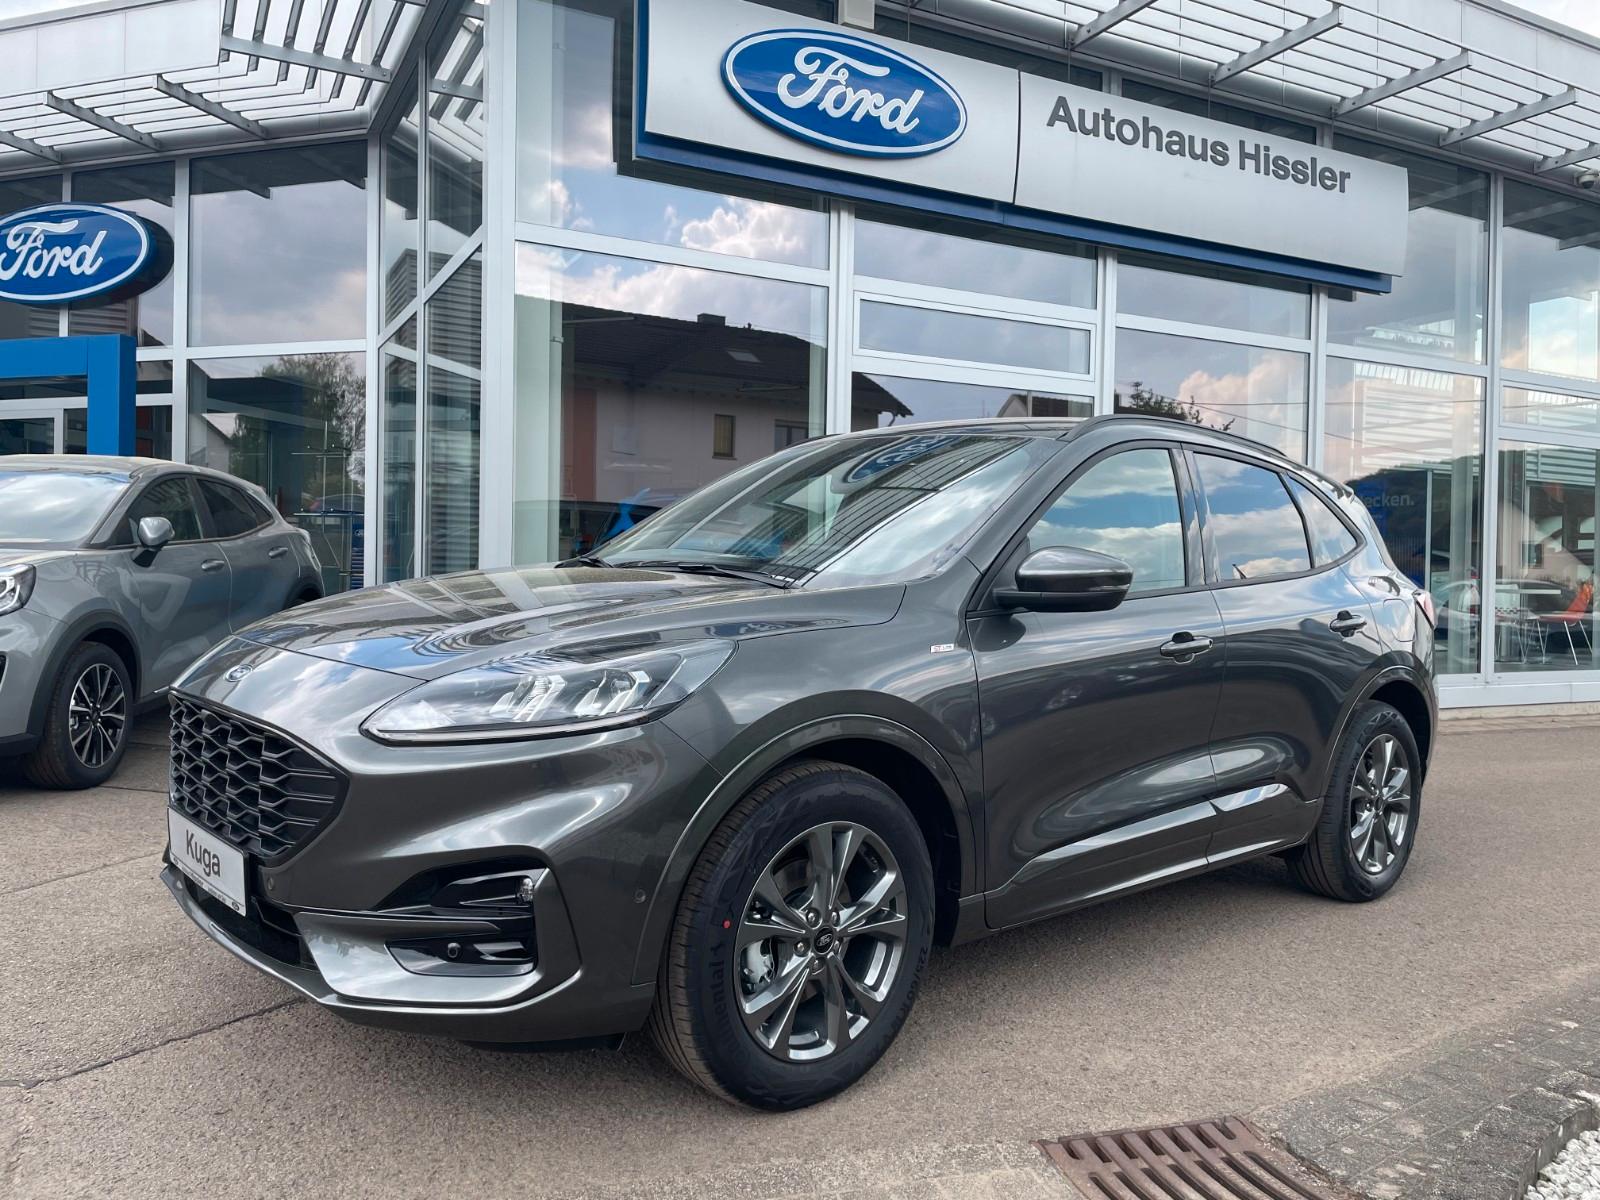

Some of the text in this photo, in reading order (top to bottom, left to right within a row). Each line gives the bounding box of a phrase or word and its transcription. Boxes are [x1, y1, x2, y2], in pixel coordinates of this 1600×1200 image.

[778, 46, 924, 134] Ford
[1047, 95, 1351, 193] Autohaus Hissler
[0, 219, 107, 281] Ford
[1362, 491, 1414, 507] ecken.
[186, 829, 220, 877] Kuga
